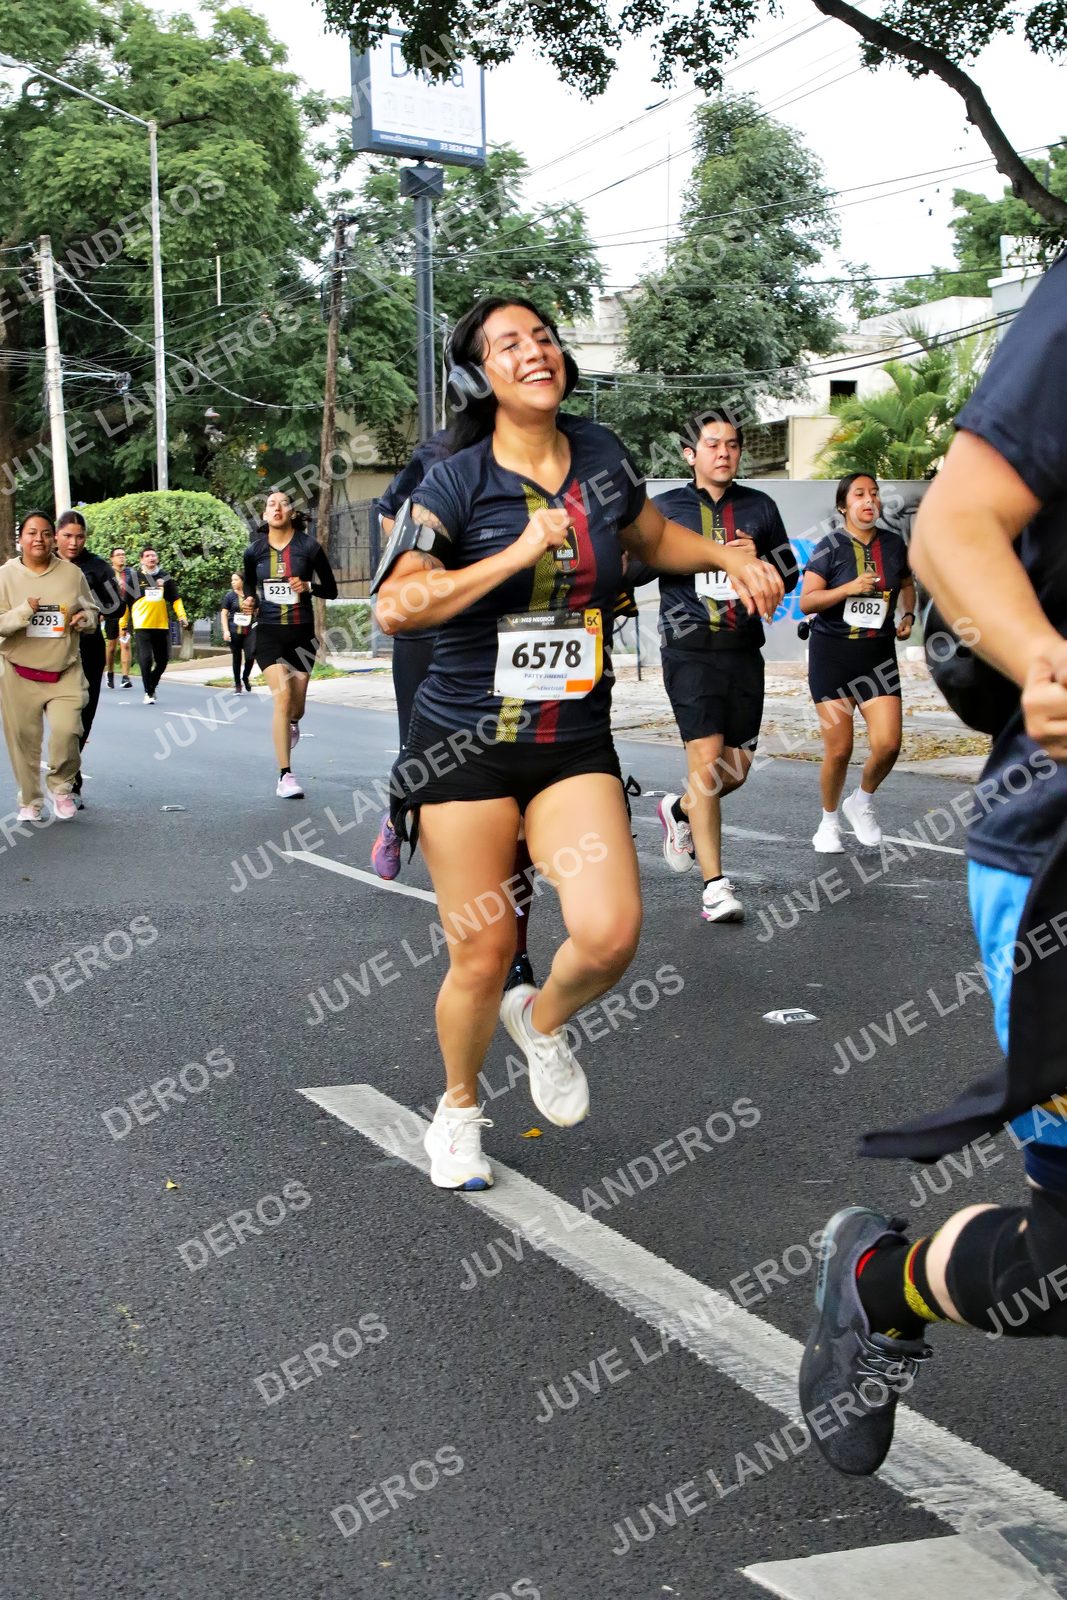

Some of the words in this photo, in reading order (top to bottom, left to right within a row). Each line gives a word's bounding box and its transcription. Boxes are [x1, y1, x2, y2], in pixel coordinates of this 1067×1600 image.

[269, 586, 292, 595] 5231
[851, 601, 880, 615] 6082
[32, 615, 58, 626] 6293
[587, 616, 599, 626] 5K
[511, 640, 582, 669] 6578
